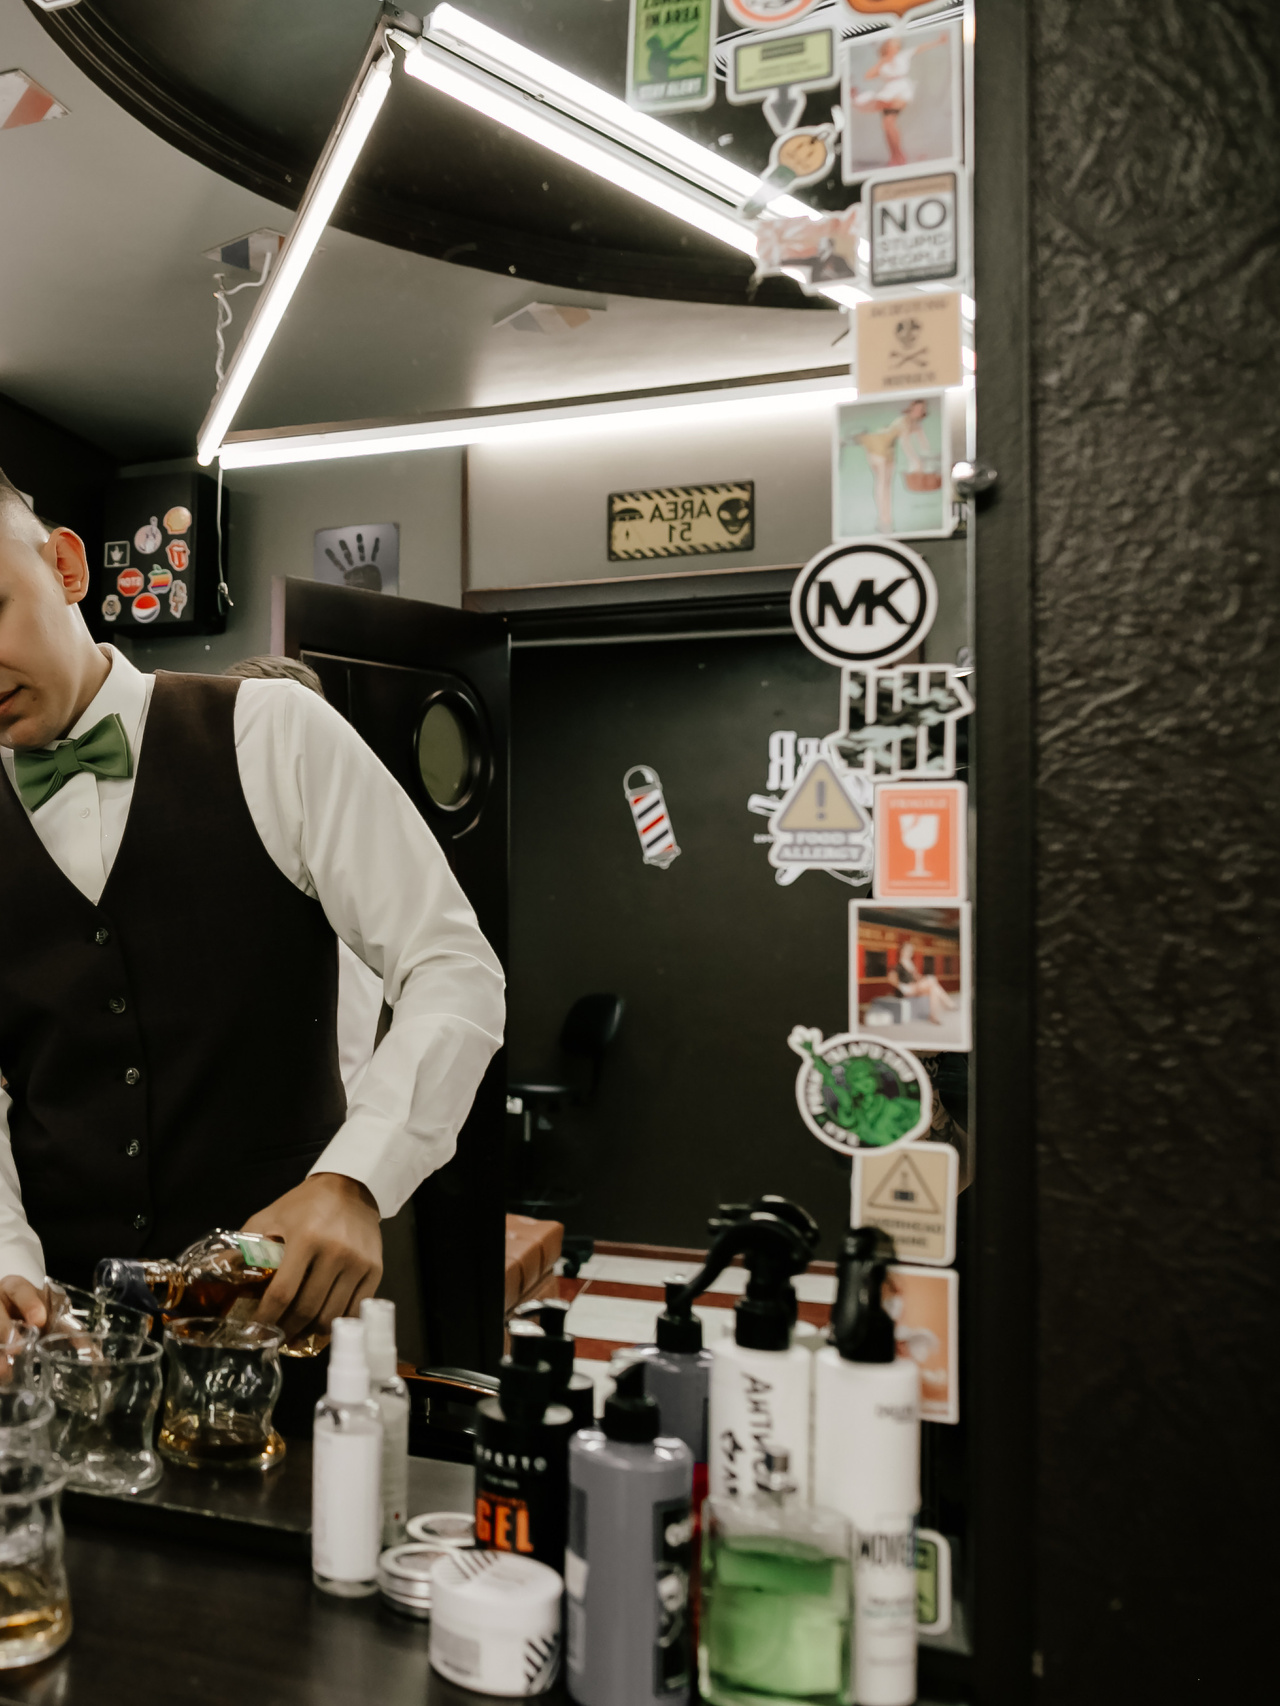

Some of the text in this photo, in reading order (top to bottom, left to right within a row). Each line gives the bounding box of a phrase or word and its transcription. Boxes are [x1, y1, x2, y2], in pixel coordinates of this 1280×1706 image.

[881, 198, 947, 236] NO
[818, 577, 909, 627] MK
[476, 1498, 535, 1553] GEL
